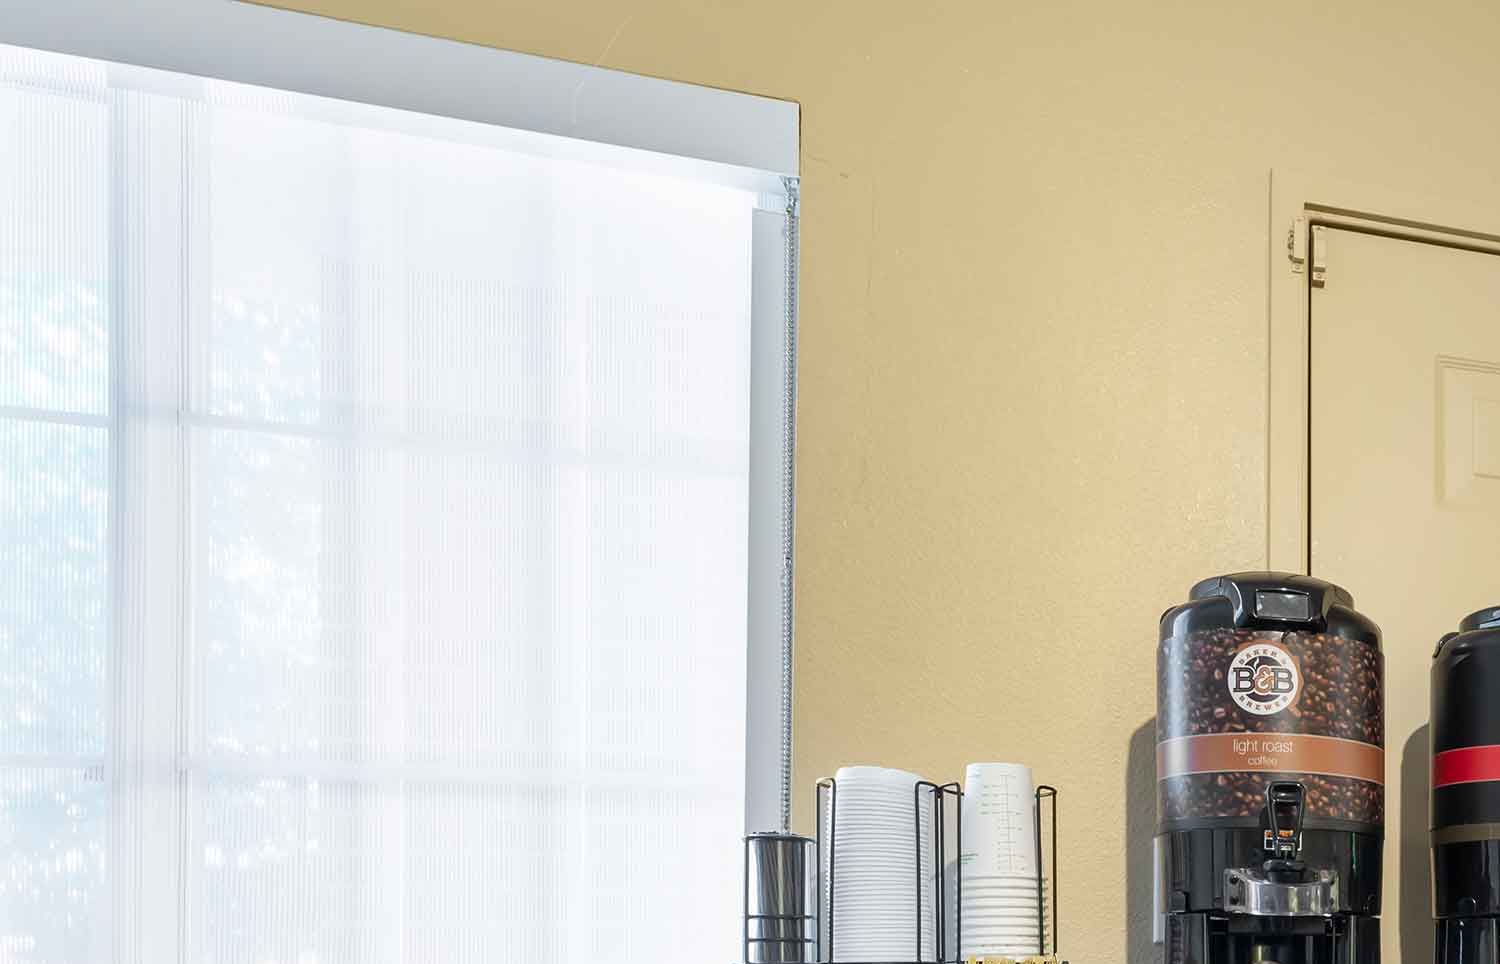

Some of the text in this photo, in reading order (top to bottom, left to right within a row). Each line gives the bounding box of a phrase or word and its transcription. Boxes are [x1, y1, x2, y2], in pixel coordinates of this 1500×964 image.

[1233, 665, 1294, 694] B&B
[1233, 739, 1294, 754] light roast
